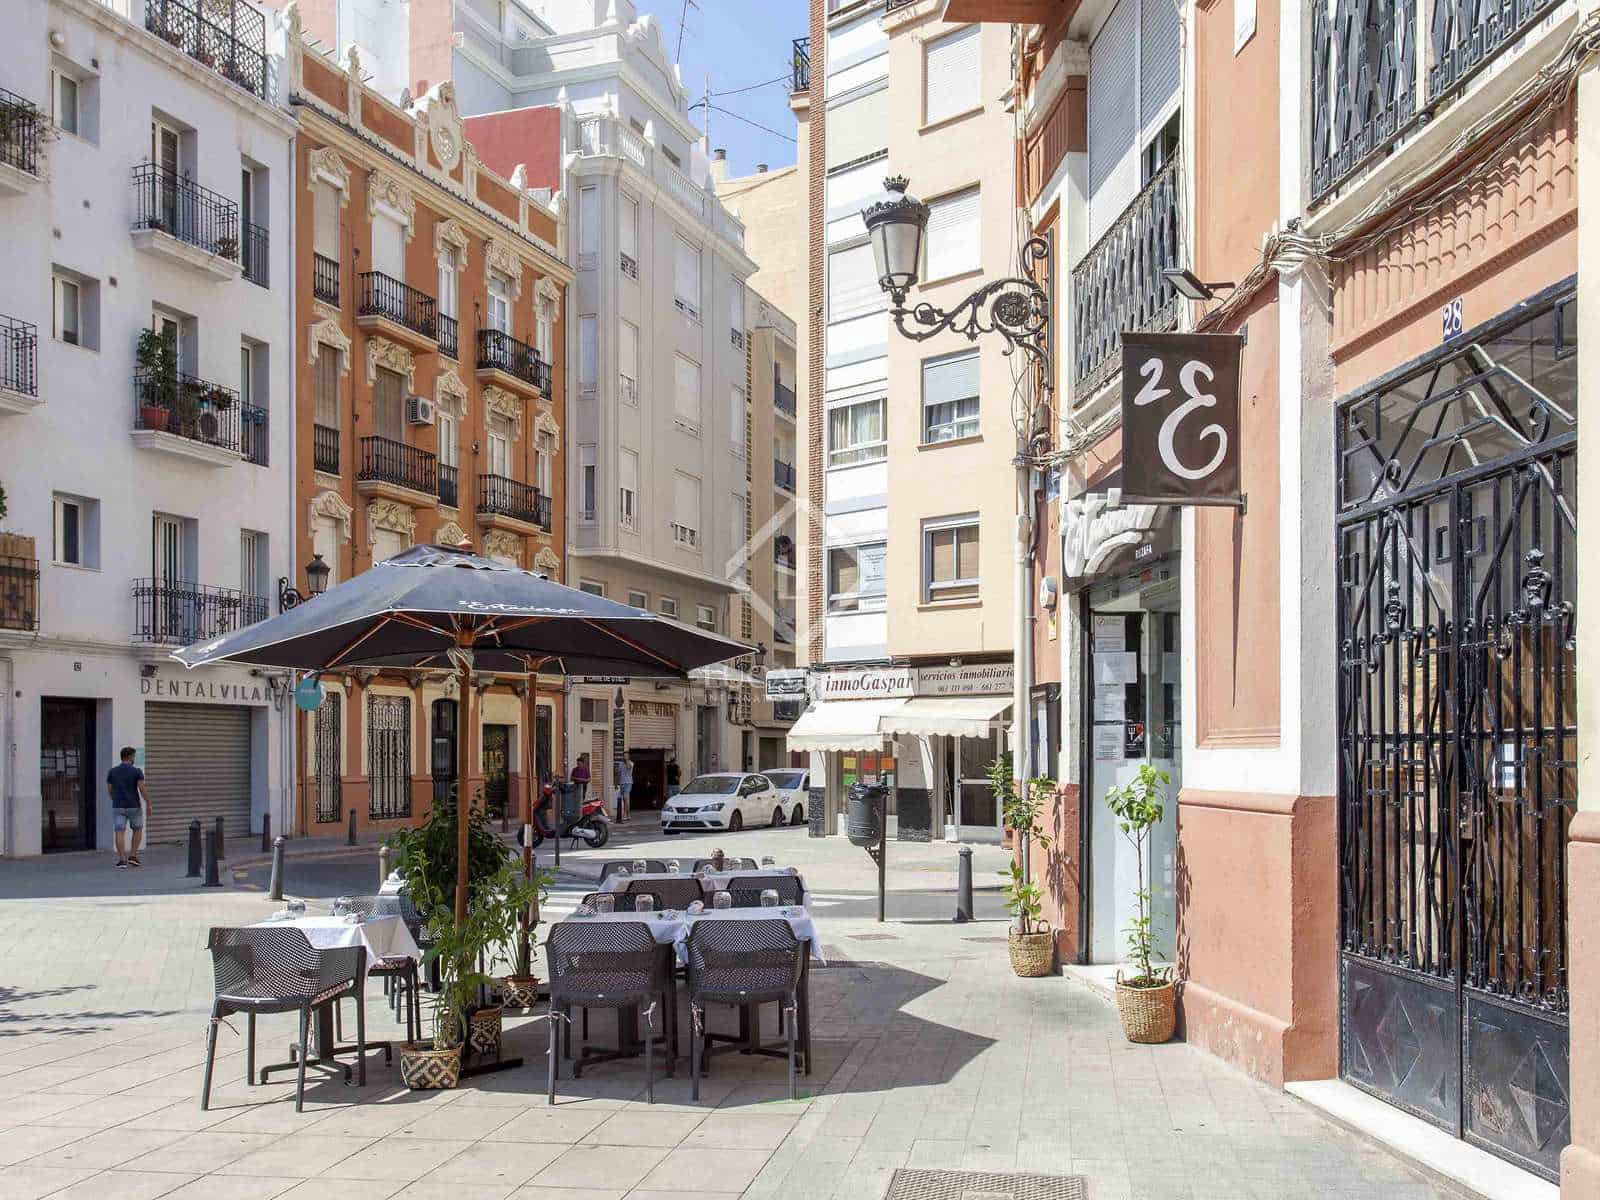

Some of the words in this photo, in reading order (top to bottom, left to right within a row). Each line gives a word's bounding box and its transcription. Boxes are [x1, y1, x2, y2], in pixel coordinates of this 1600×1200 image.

[1443, 299, 1462, 337] 28
[826, 673, 913, 692] inmoGaspar
[920, 671, 956, 681] servicios
